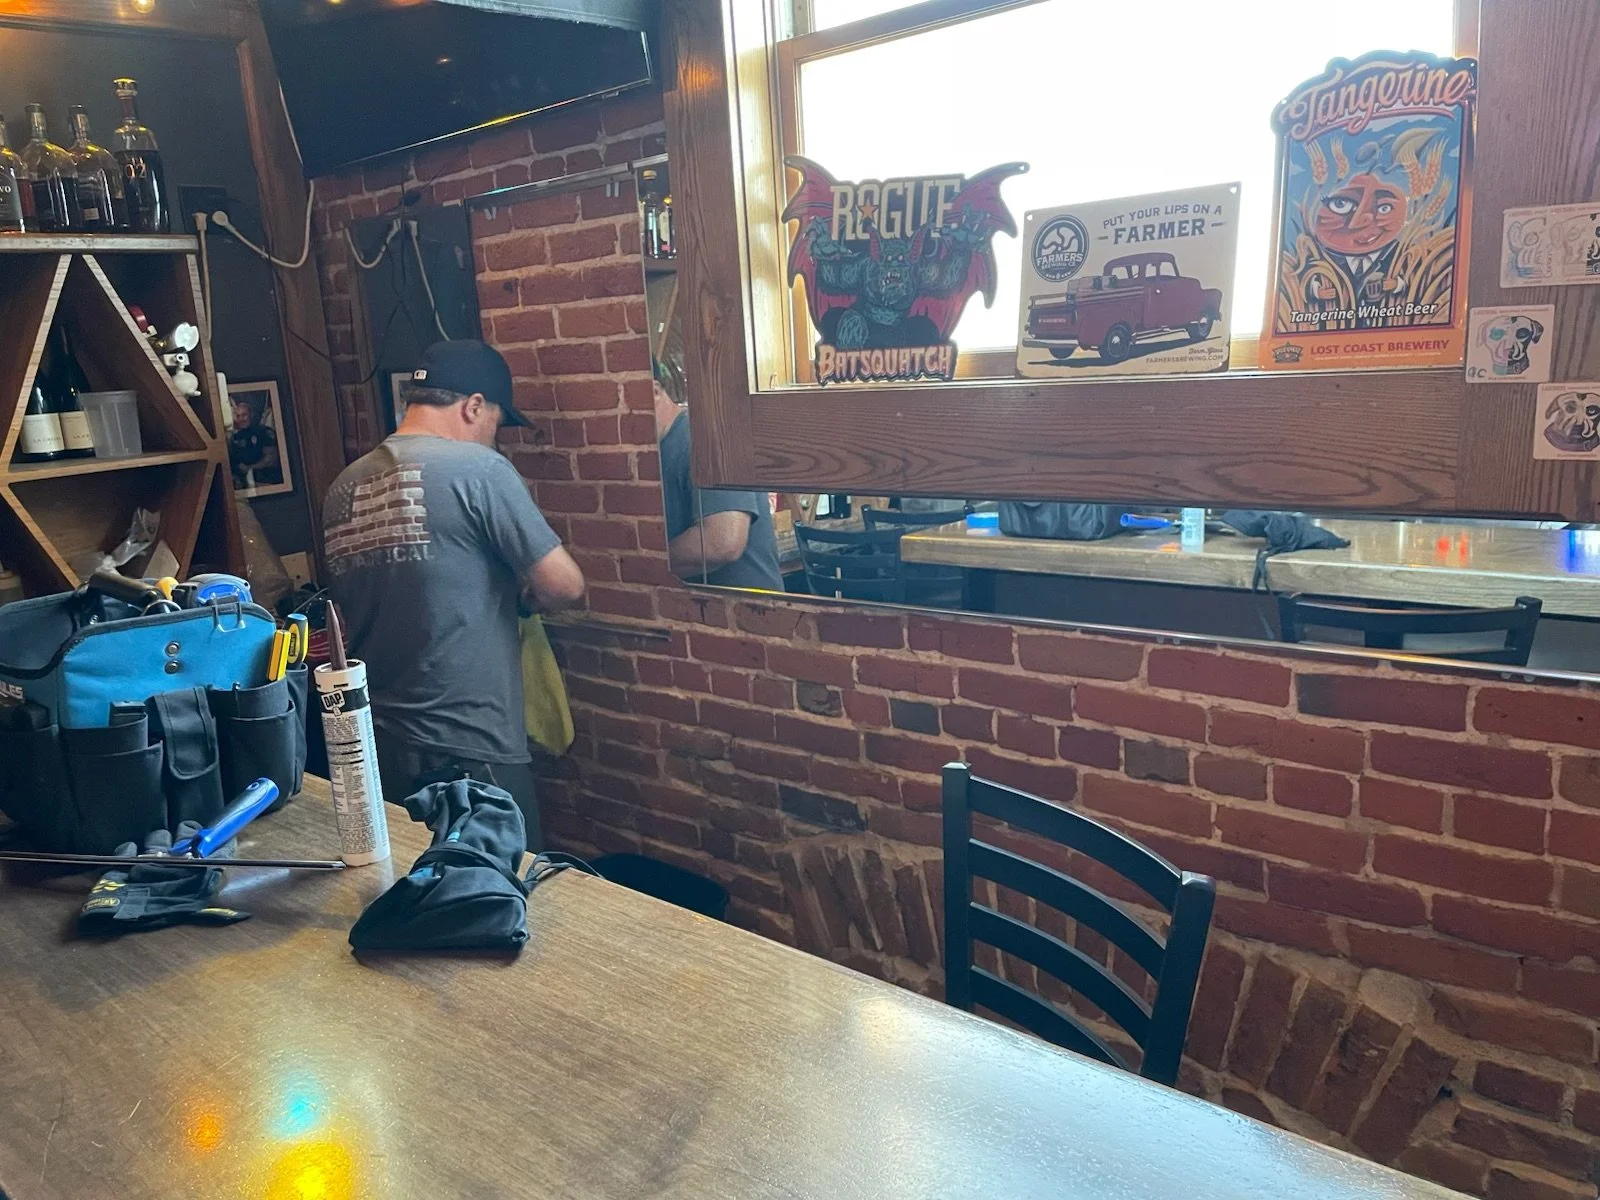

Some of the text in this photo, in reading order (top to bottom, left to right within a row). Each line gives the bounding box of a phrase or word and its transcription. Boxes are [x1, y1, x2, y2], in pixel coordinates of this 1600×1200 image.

[1280, 61, 1475, 141] Tangerine
[830, 178, 961, 241] ROGUE
[1103, 203, 1223, 229] PUT YOUR LIPS ON A
[1113, 218, 1205, 245] FARMER
[1036, 252, 1084, 267] FARMERS
[1290, 303, 1438, 325] Tangerine Wheat Beer
[1310, 345, 1340, 355] LOST
[1343, 343, 1384, 354] COAST
[1387, 340, 1450, 351] BREWERY
[820, 345, 952, 378] BATSQUATCH
[323, 693, 342, 708] DAP
